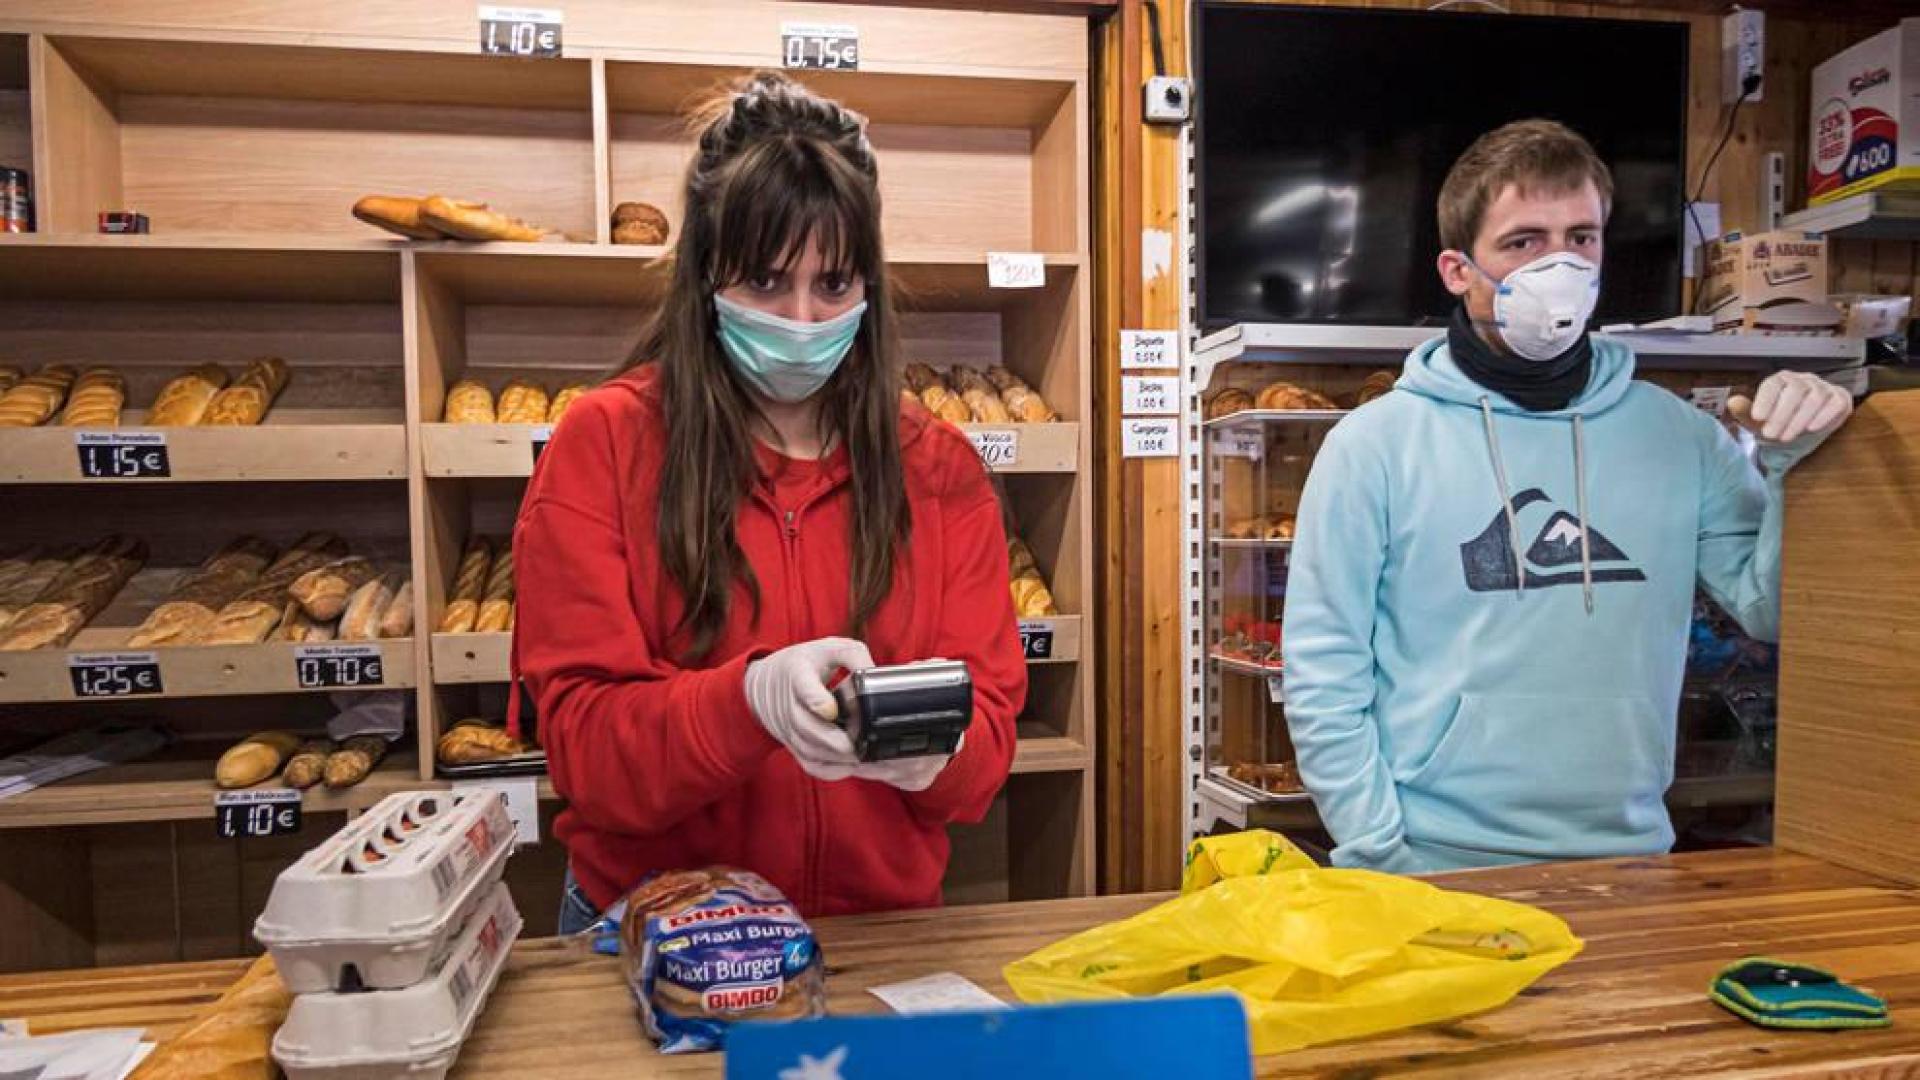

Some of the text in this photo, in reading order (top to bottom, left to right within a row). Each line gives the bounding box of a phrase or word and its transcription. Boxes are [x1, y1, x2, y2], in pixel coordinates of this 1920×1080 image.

[692, 927, 742, 946] Maxi
[666, 955, 783, 982] Maxi Burger
[707, 986, 779, 1010] BIMBO
